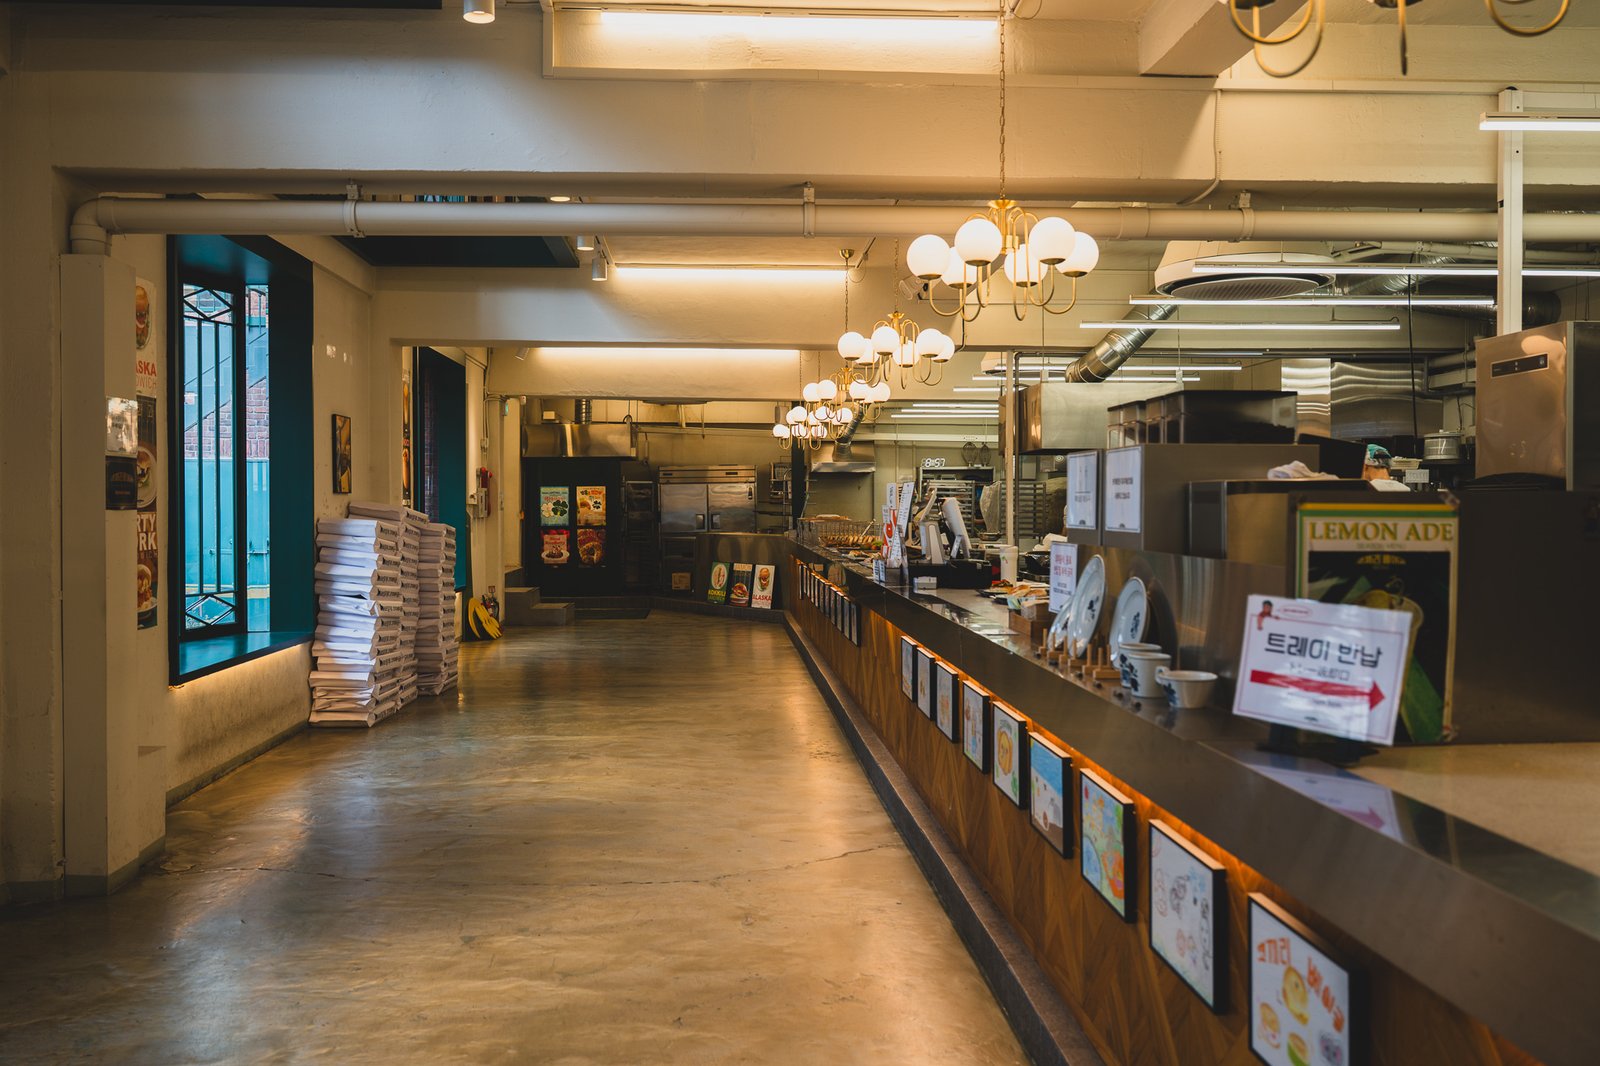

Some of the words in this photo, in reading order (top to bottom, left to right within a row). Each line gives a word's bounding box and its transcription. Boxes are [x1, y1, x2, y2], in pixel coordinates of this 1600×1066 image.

[924, 457, 946, 468] 8:57
[1309, 521, 1399, 541] LEMON
[1405, 522, 1454, 541] ADE
[1264, 632, 1330, 661] 트레이
[1338, 643, 1383, 668] 반납
